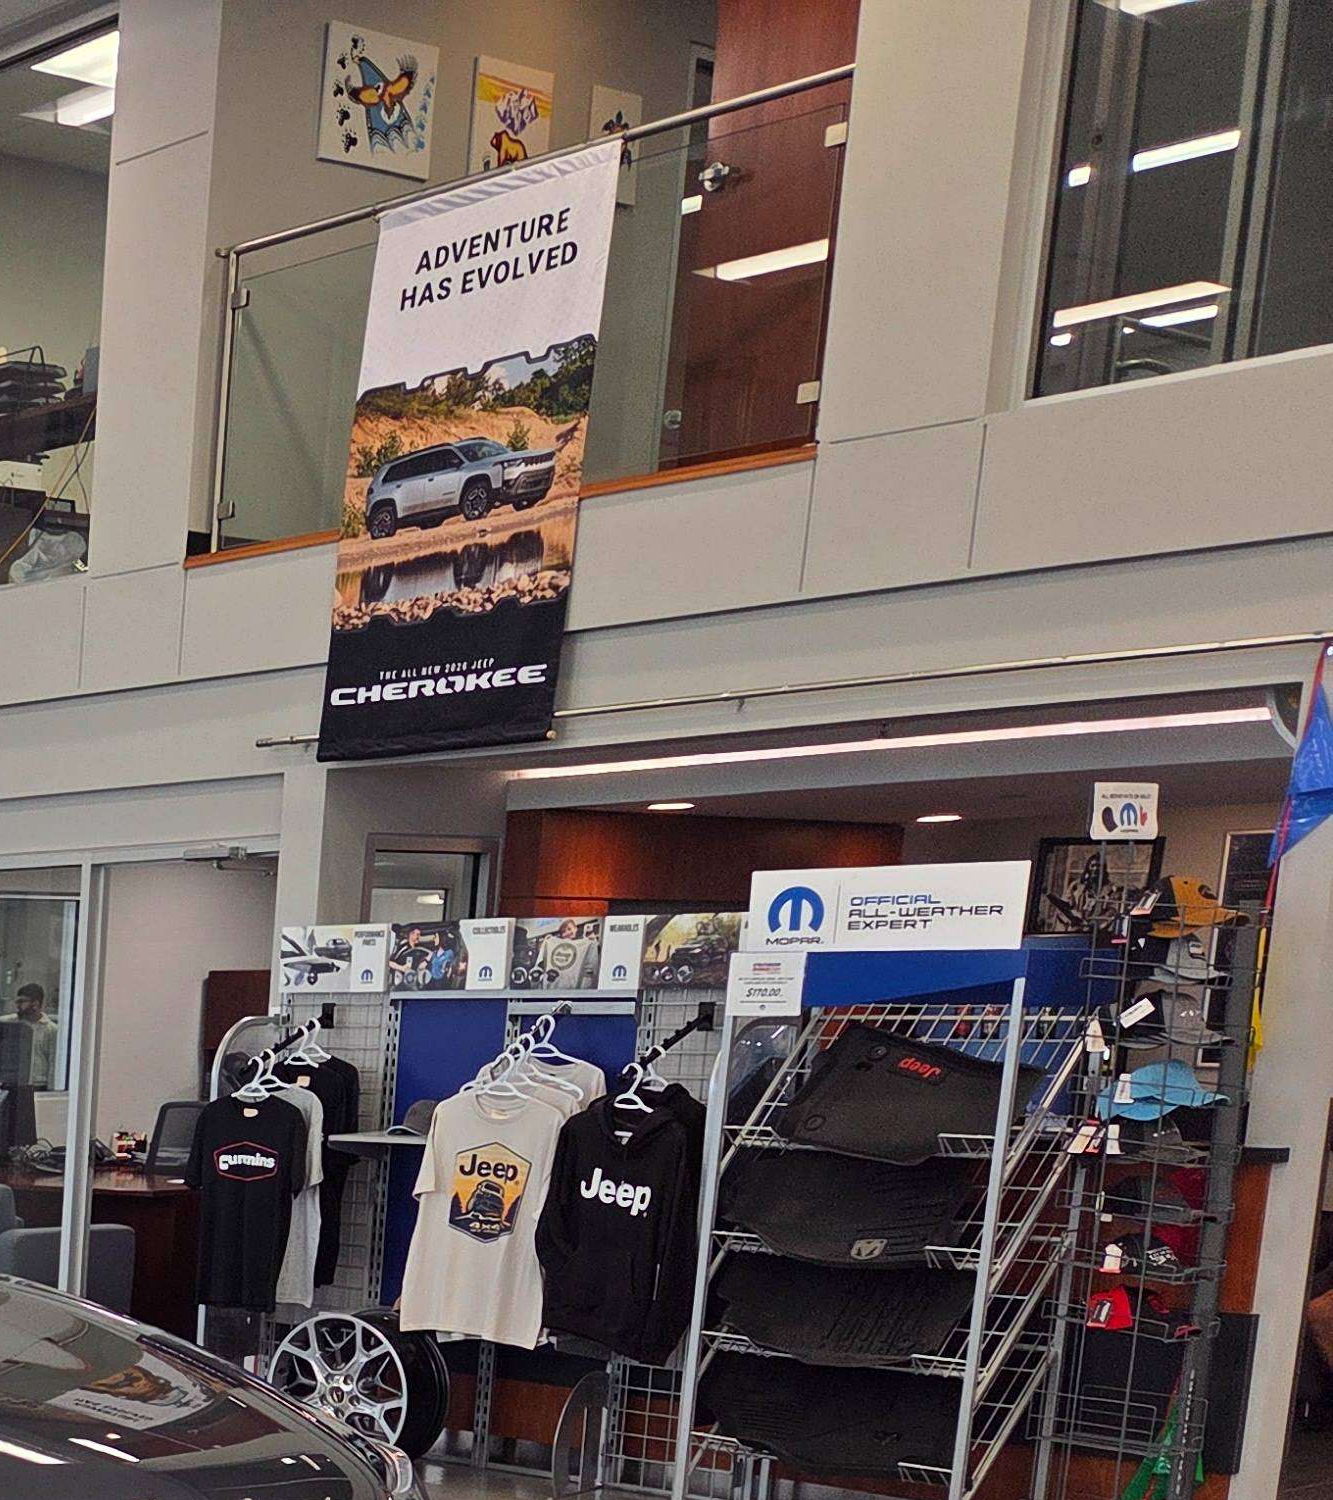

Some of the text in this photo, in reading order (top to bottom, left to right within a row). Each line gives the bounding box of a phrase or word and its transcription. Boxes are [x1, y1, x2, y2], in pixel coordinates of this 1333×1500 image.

[414, 206, 571, 276] ADVENTURE
[399, 240, 579, 312] HAS EVOLVED
[379, 670, 397, 681] THE
[401, 667, 417, 679] ALL
[421, 665, 441, 676] NEW
[471, 657, 495, 670] JEEP
[329, 663, 549, 706] CHEROKEE
[848, 905, 1004, 919] ALL-WEATHER
[850, 893, 941, 907] OFFICIAL
[847, 919, 933, 931] EXPERT
[765, 936, 821, 946] MOPAR
[459, 1153, 518, 1183] Jeep
[579, 1167, 652, 1217] Jeep
